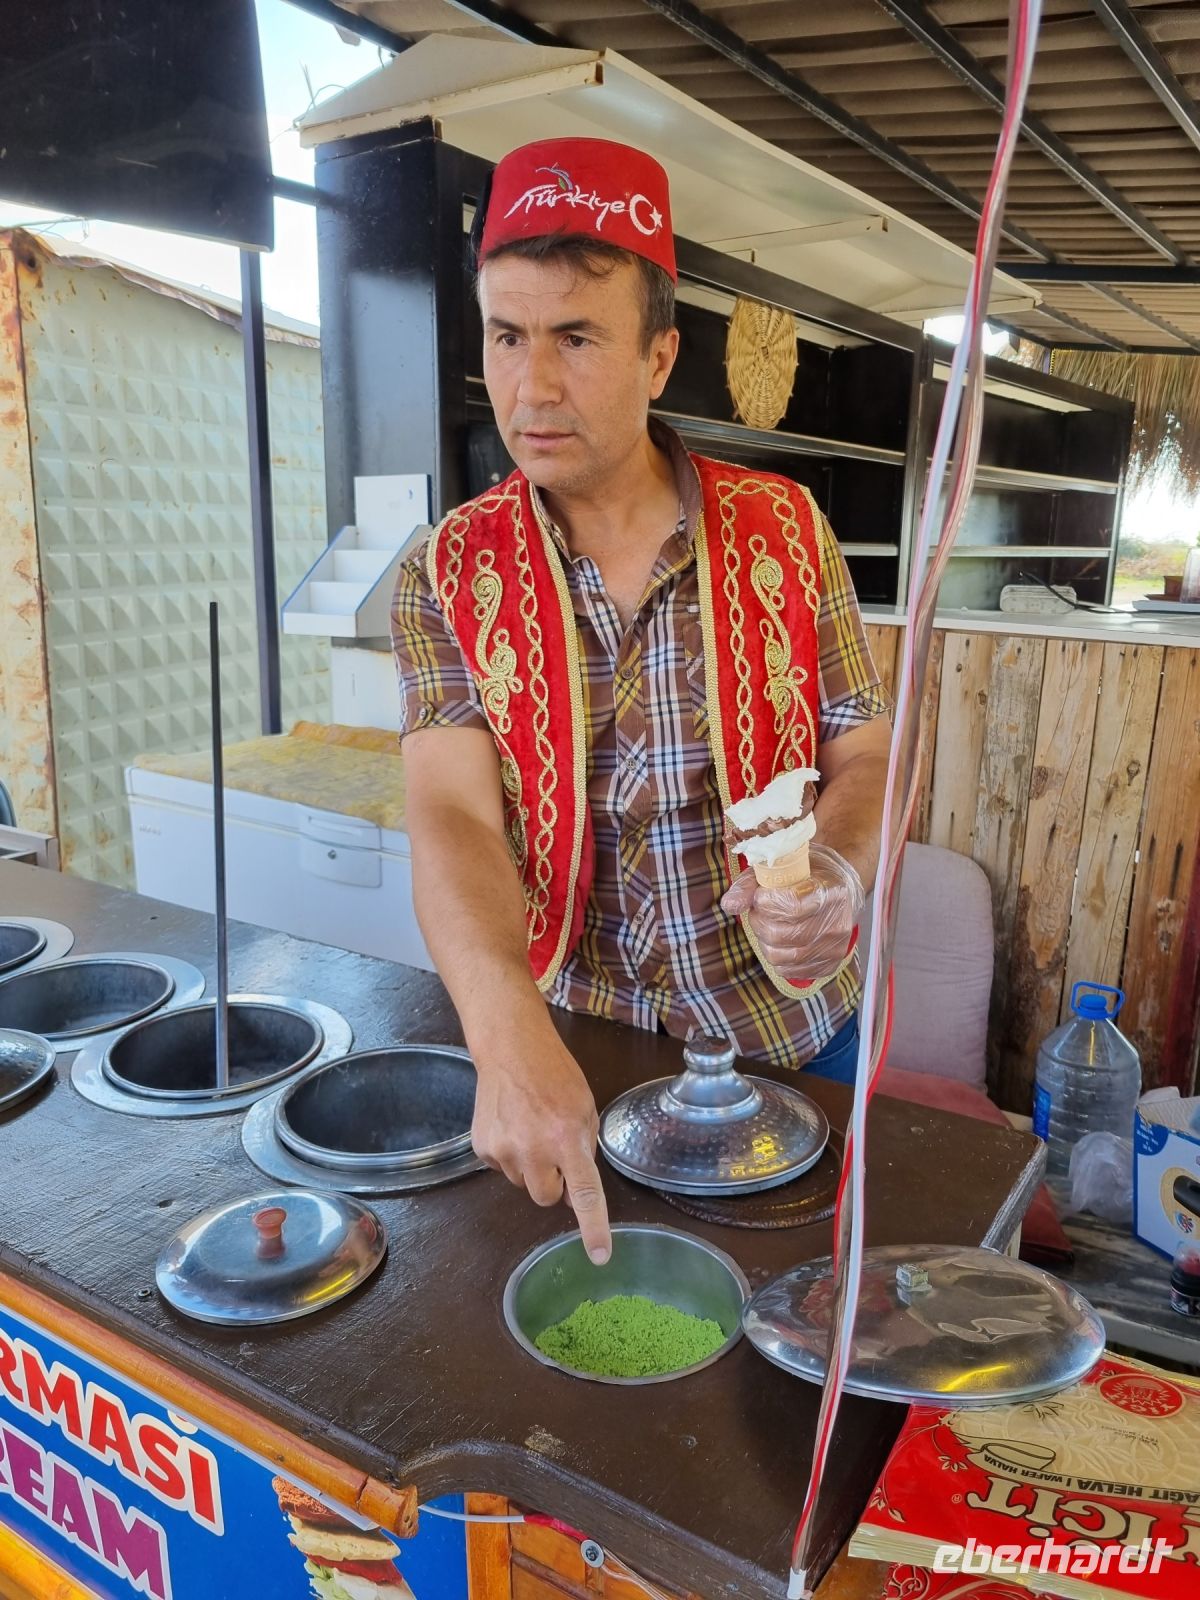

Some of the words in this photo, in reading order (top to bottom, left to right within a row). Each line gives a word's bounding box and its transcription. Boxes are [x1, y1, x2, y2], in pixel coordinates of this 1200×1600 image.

[503, 184, 626, 231] Türkiye
[983, 1453, 1018, 1475] HALVA
[1022, 1469, 1063, 1483] WAFER
[1076, 1478, 1143, 1497] HELVA
[0, 1424, 168, 1600] EAM
